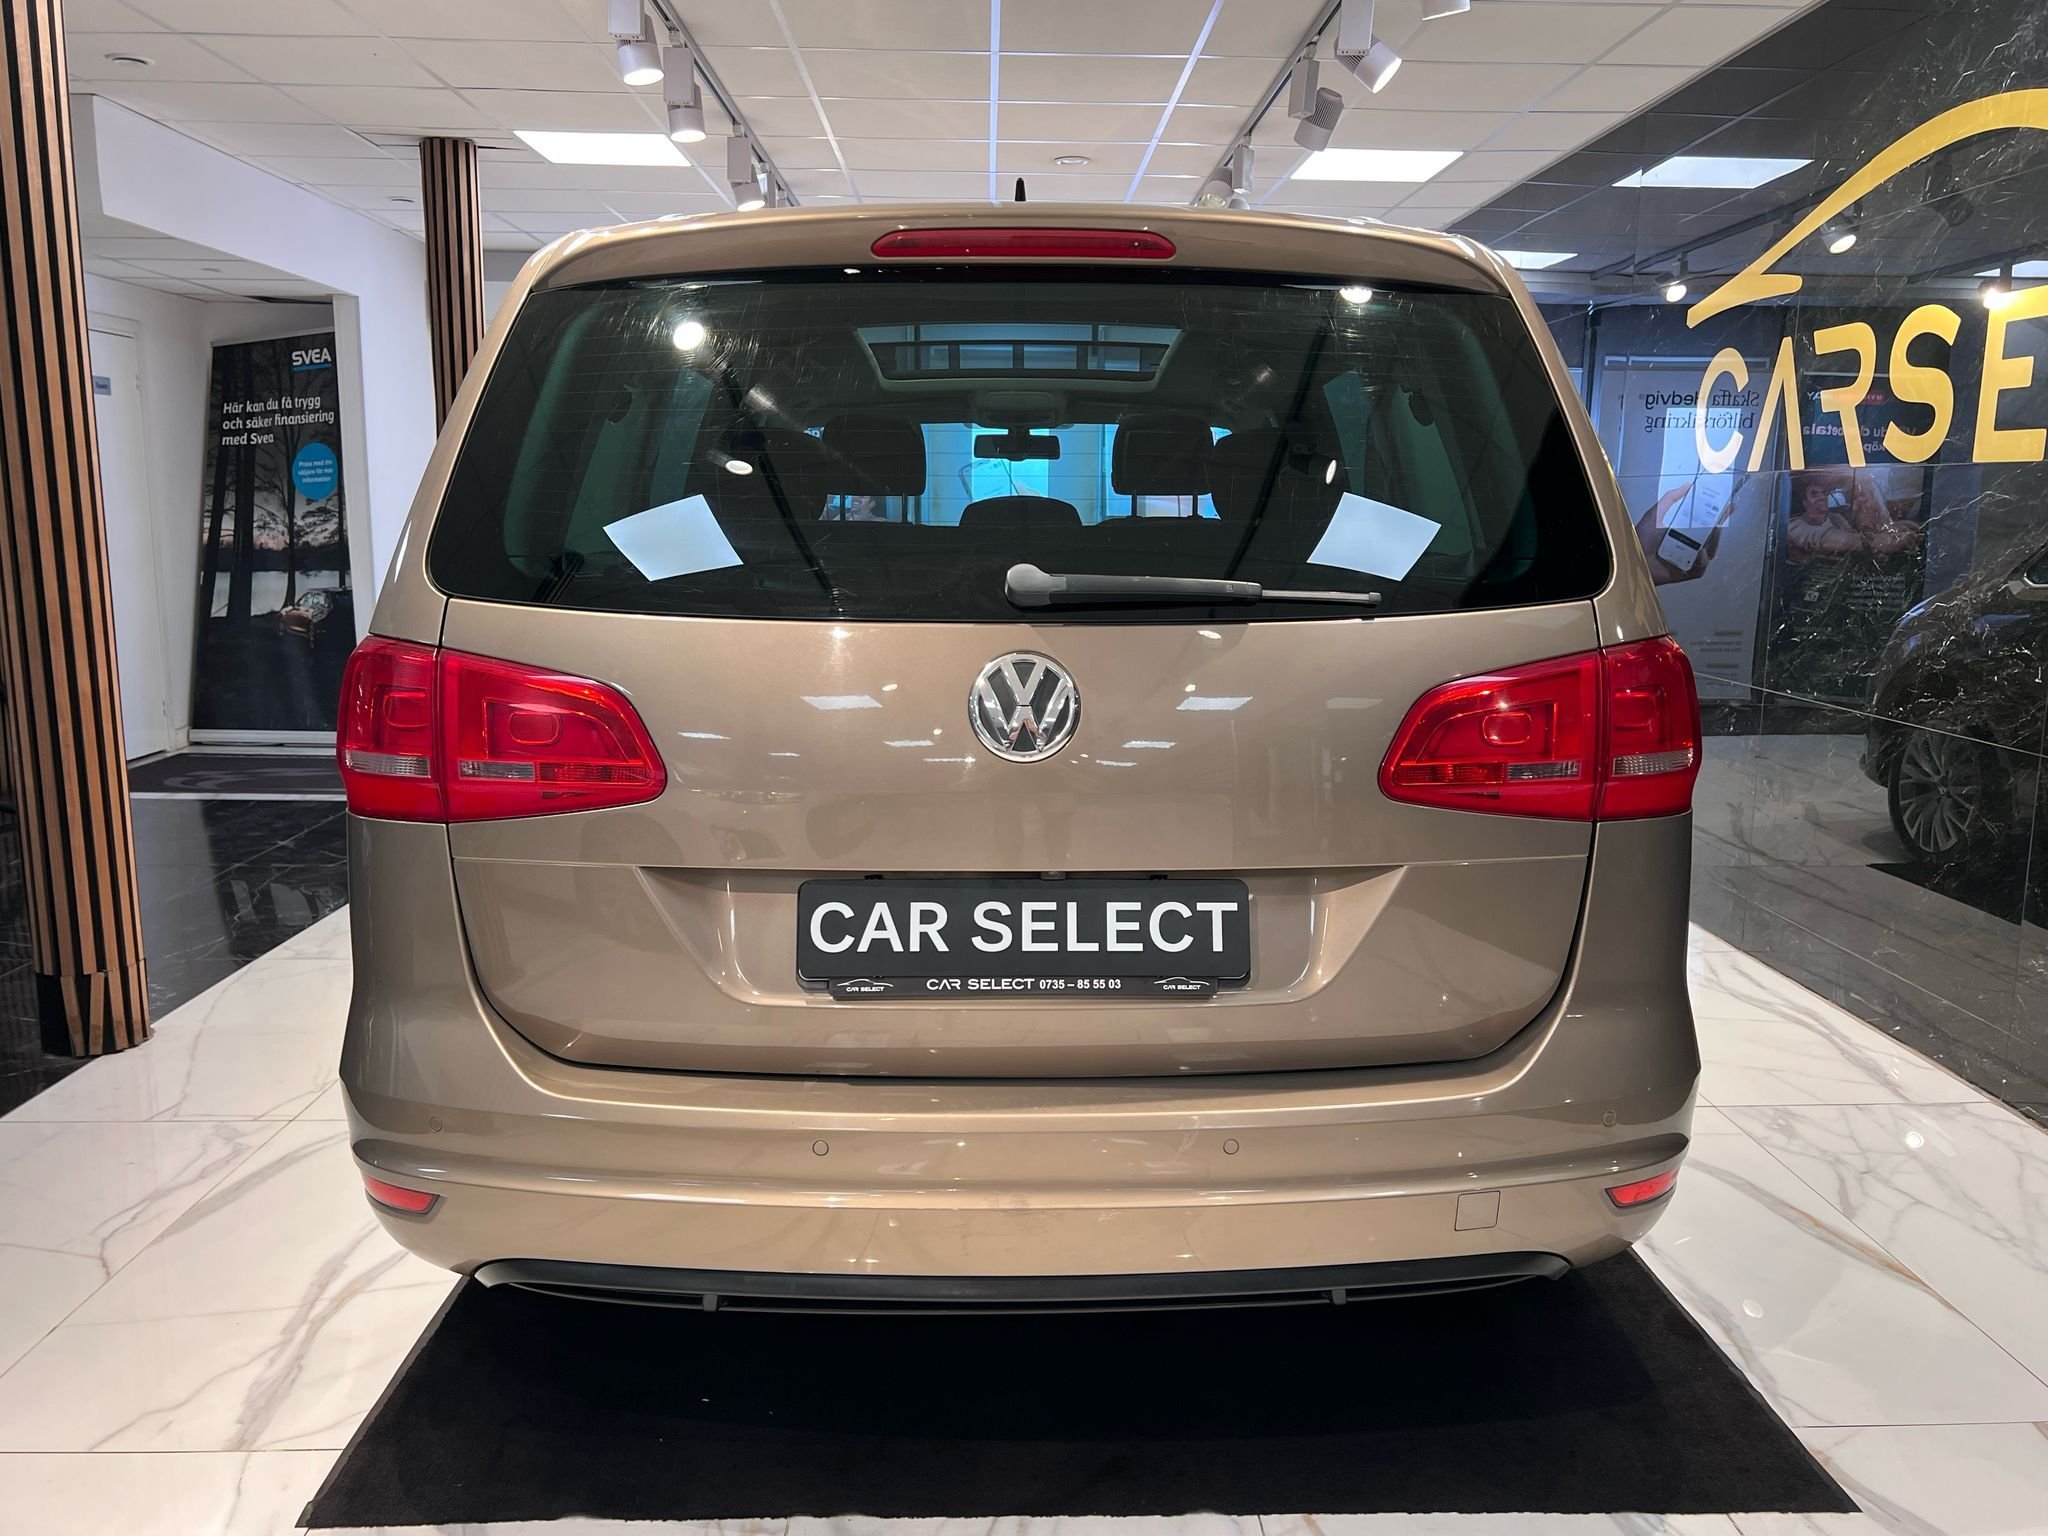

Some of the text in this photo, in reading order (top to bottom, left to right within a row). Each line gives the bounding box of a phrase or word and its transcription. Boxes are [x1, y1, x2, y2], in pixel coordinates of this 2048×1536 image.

[292, 348, 332, 366] SVEA
[223, 396, 321, 414] Här kan du få trygg
[222, 410, 335, 430] och säker finansiering
[222, 432, 274, 446] med Svea
[809, 901, 1238, 953] CAR SELECT
[926, 978, 961, 990] CAR
[967, 978, 1035, 990] SELECT
[1039, 979, 1065, 989] 0735
[1077, 979, 1090, 989] 85
[1092, 979, 1106, 989] 55
[1108, 979, 1122, 989] 03
